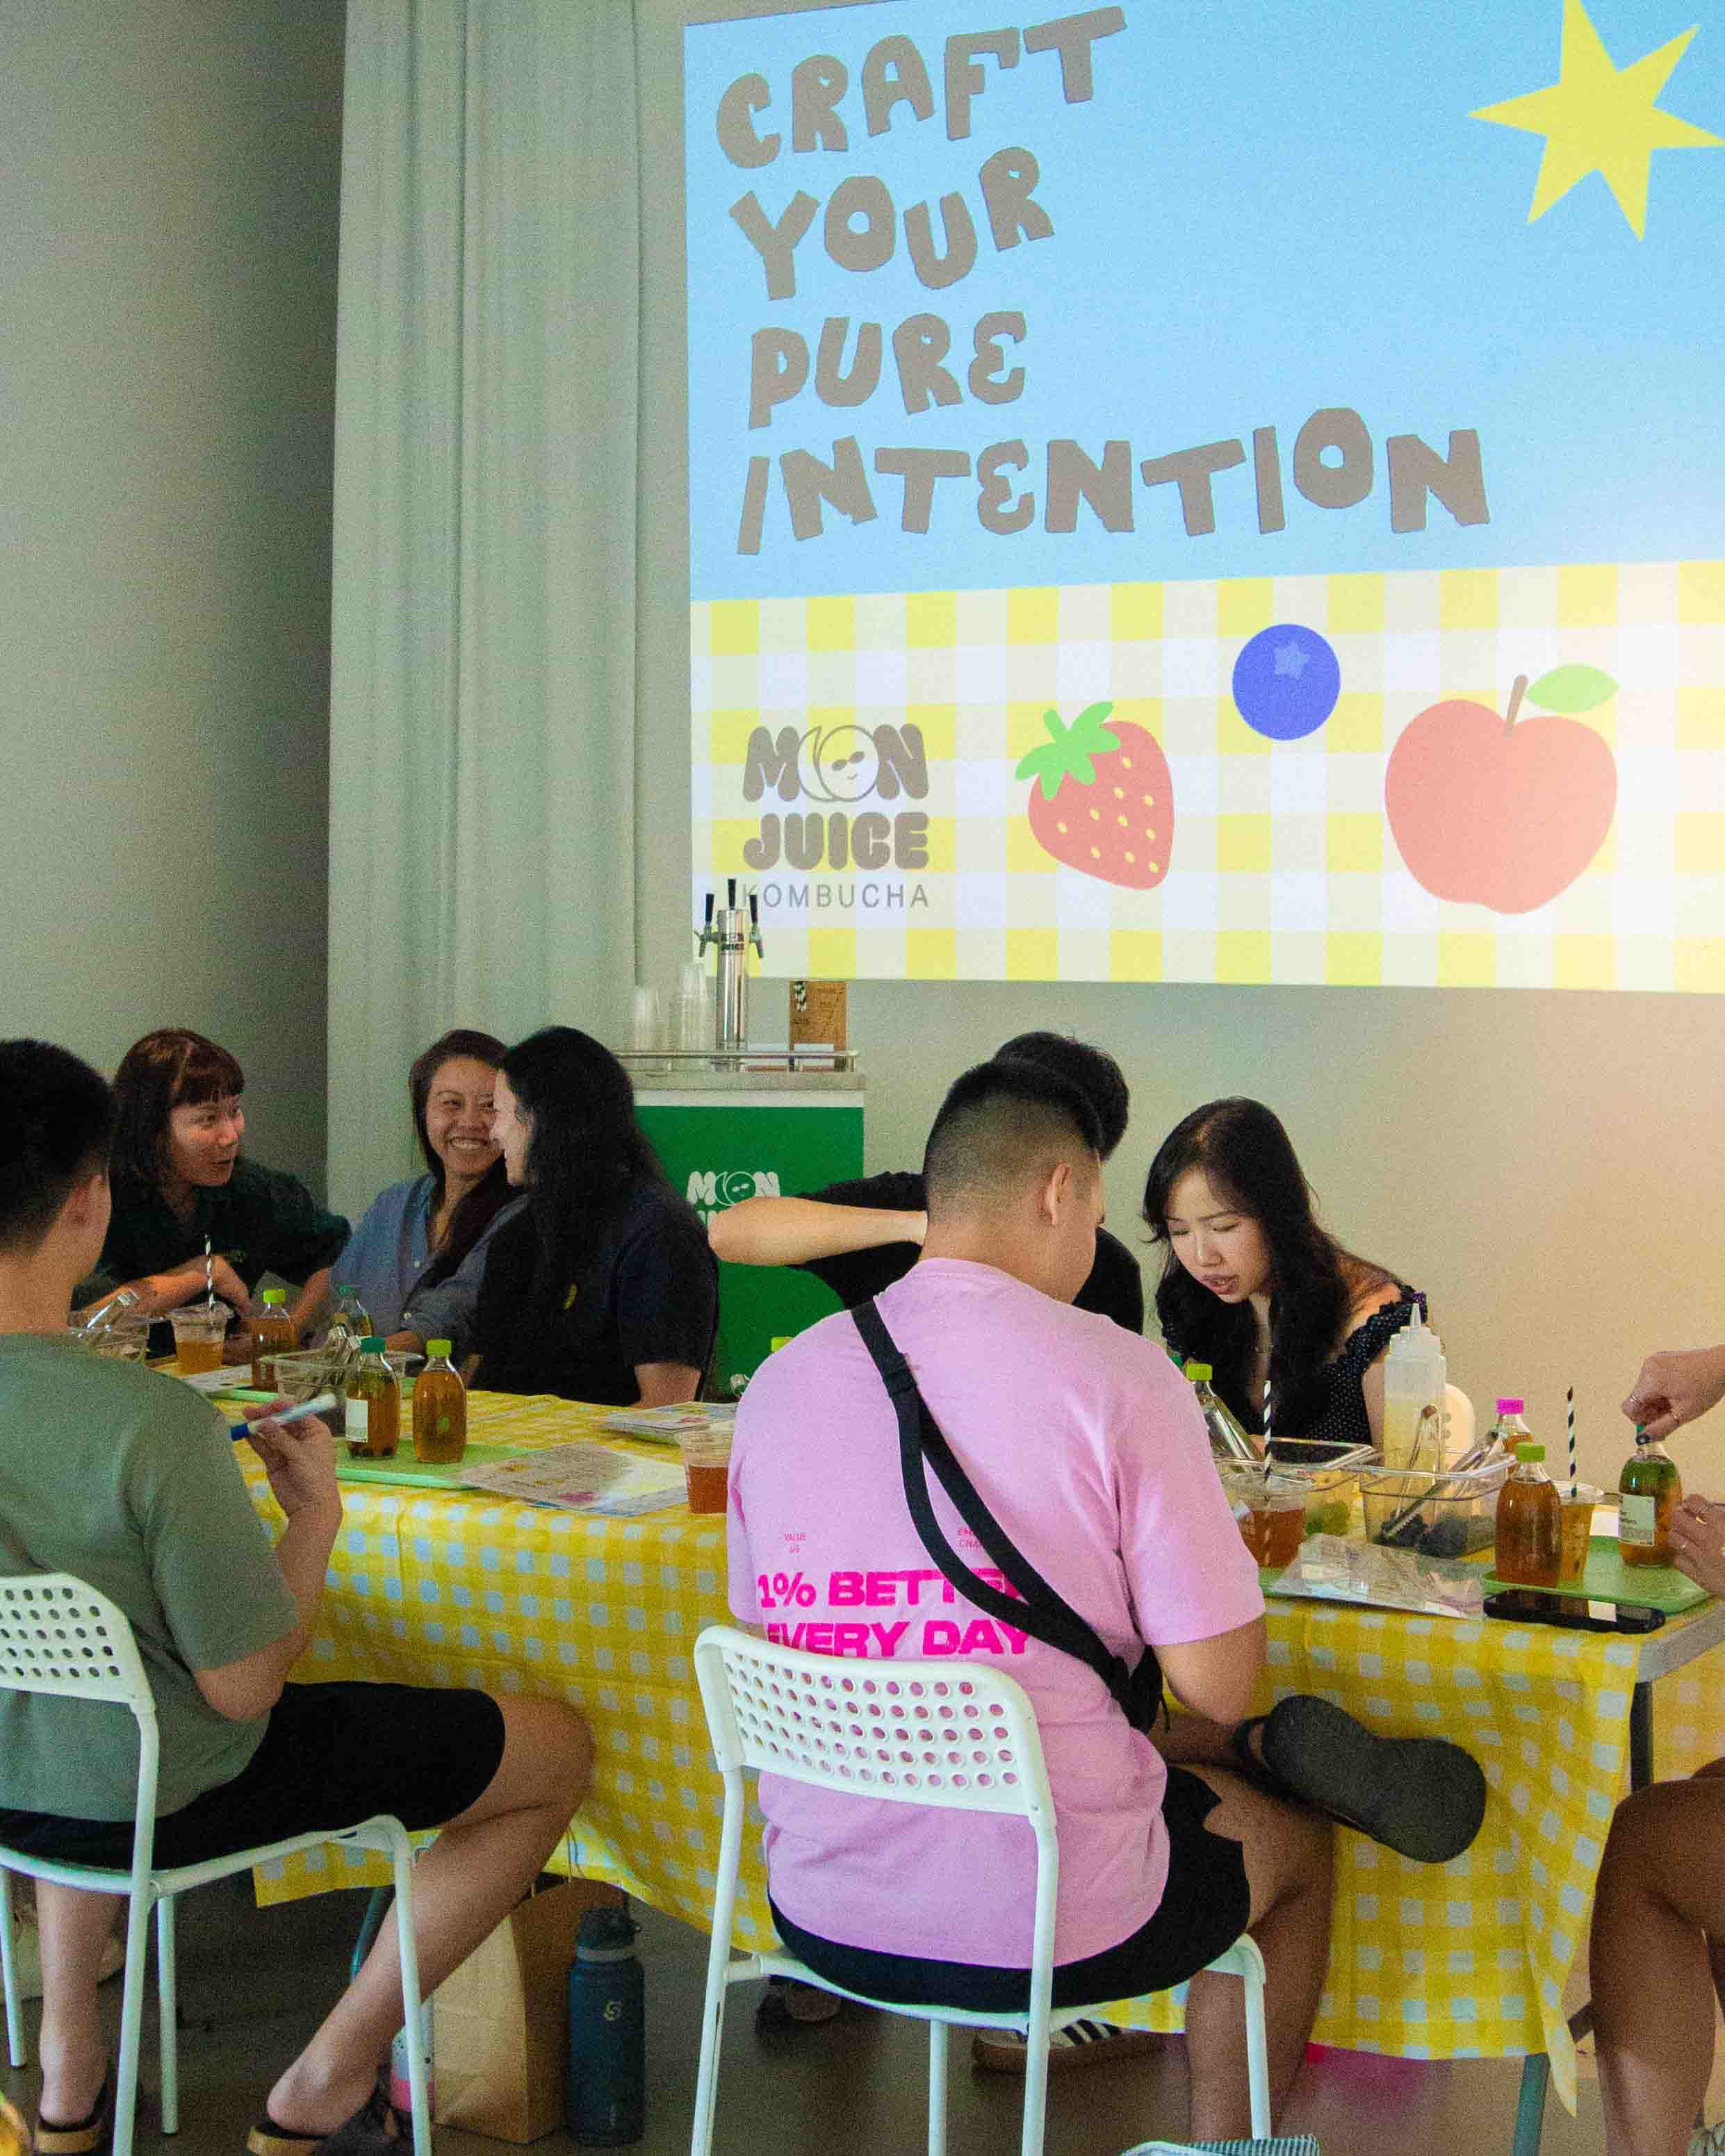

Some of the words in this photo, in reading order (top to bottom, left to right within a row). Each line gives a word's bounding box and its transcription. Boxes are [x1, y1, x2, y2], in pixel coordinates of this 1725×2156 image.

[716, 6, 1127, 168] CRAFT
[728, 147, 1054, 301] YOUR
[749, 311, 1027, 429] PURE
[737, 406, 1490, 555] INTENTION
[743, 812, 929, 870] JUICE
[742, 883, 929, 908] KOMBUCHA
[758, 1572, 817, 1608] 1%
[767, 1621, 911, 1658] EVERY
[922, 1620, 1029, 1656] DAY
